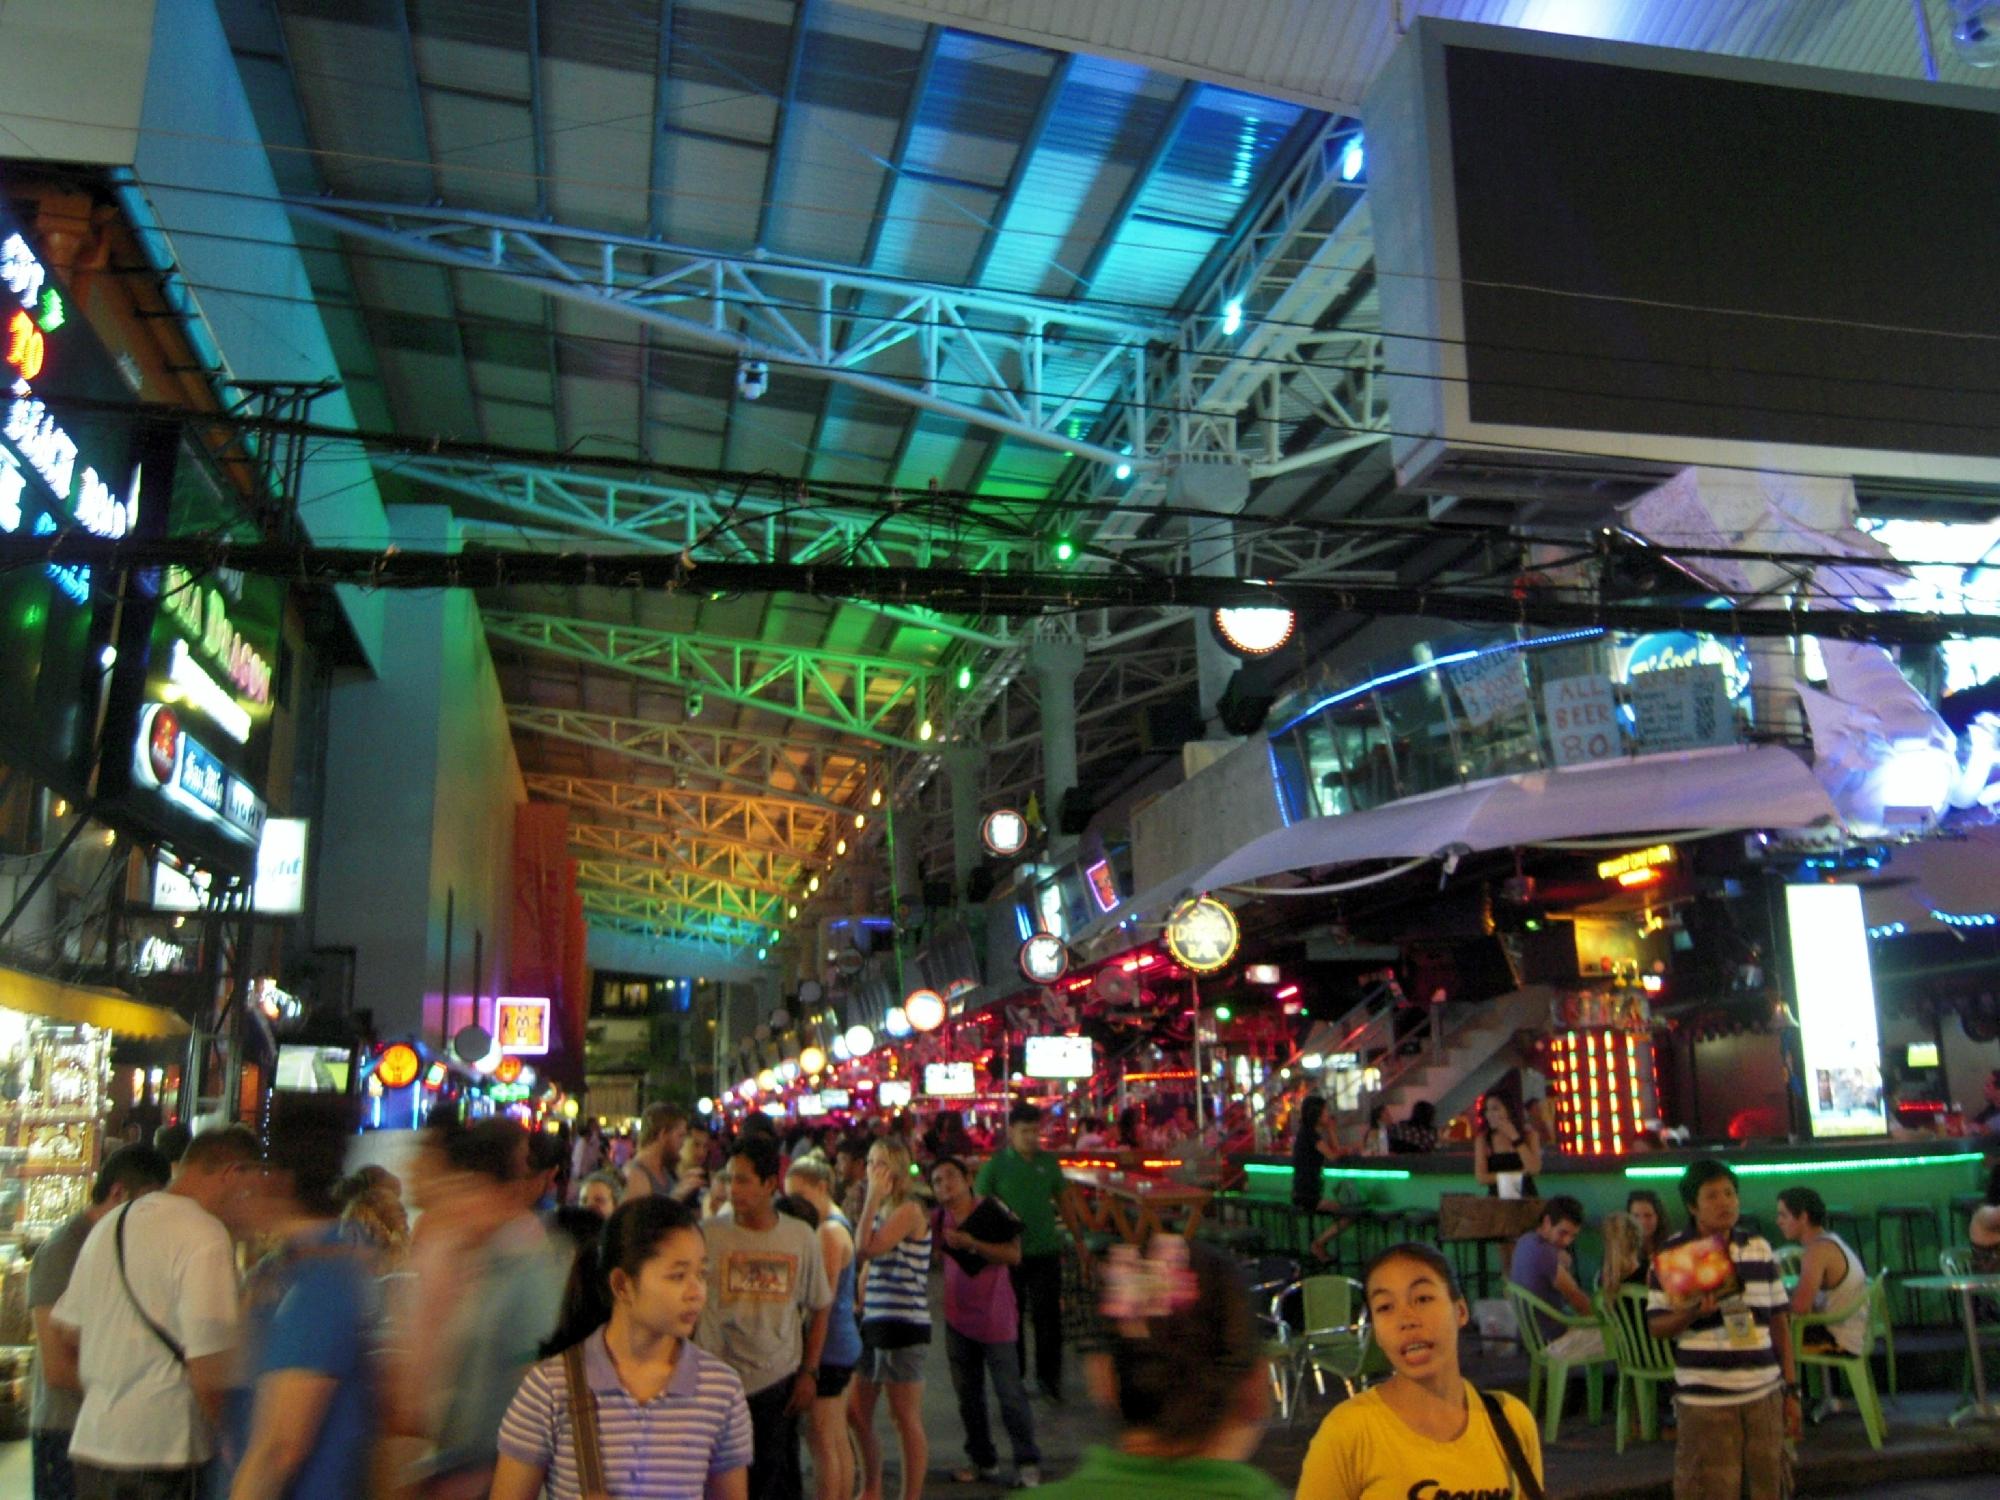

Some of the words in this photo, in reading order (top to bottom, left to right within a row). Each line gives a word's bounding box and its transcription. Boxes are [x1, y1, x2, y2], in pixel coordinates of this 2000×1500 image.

[1561, 678, 1604, 701] ALL
[1556, 703, 1610, 729] BEER
[1562, 732, 1611, 761] 80
